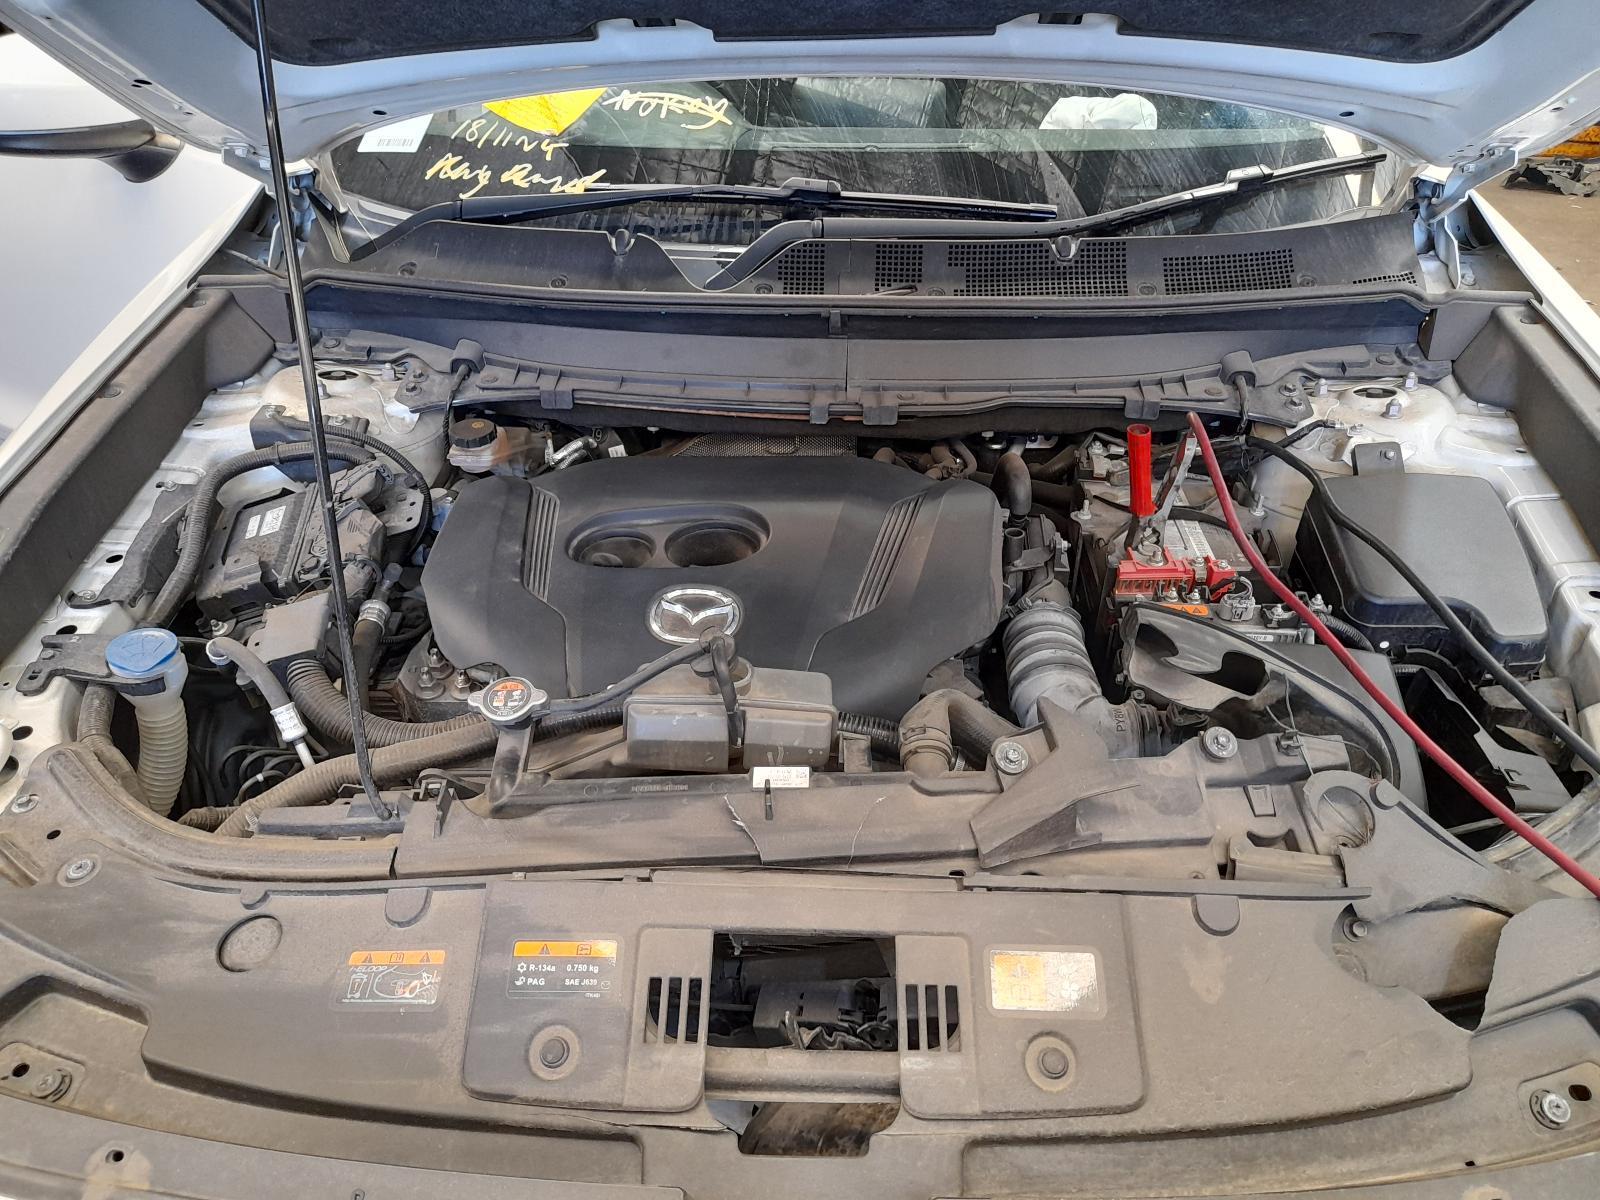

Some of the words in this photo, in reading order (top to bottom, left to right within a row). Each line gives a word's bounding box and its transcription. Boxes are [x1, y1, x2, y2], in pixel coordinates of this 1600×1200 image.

[529, 964, 556, 972] R-134a
[566, 964, 588, 972] 0.750
[589, 964, 599, 974] kg
[527, 978, 545, 986] PAG
[565, 978, 579, 986] SAE
[581, 978, 598, 986] J639
